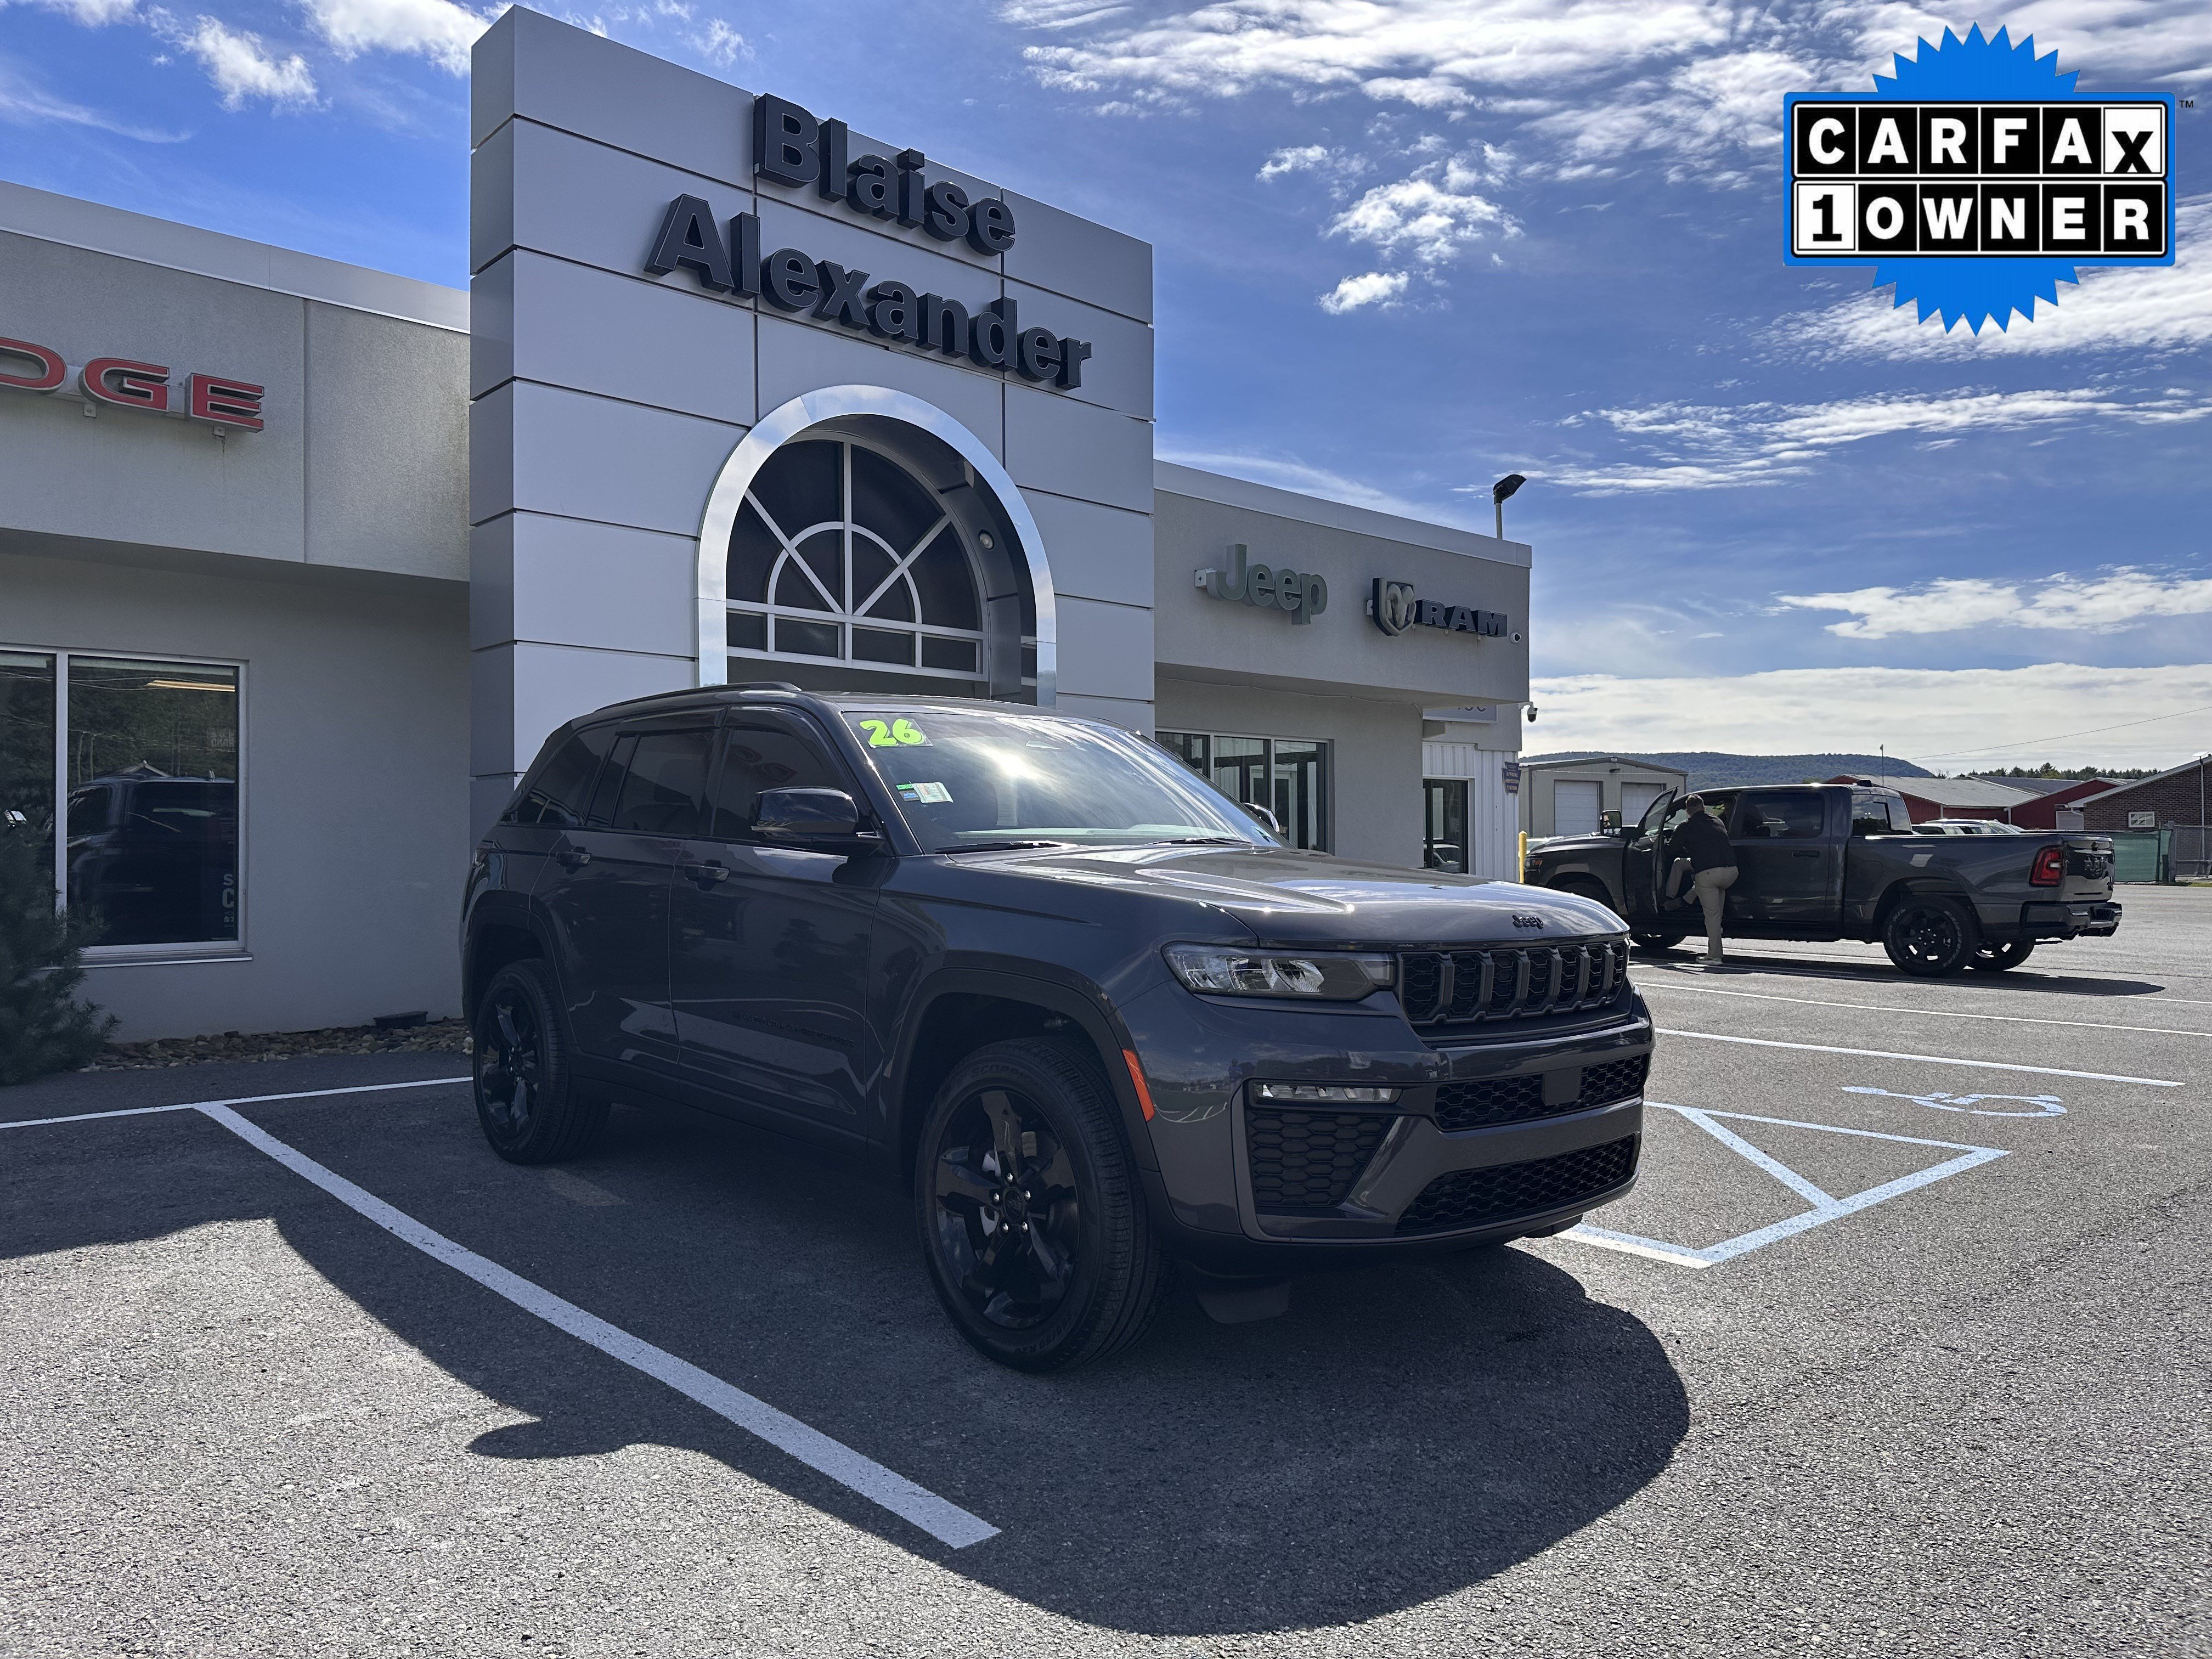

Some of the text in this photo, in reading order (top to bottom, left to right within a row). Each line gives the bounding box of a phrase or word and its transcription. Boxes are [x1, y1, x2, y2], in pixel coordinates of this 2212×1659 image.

[754, 92, 1016, 257] Blaise
[644, 193, 1092, 391] Alexander
[1206, 543, 1328, 625] Jeep
[1414, 599, 1508, 637] RAM
[859, 719, 926, 747] 26
[1512, 915, 1544, 929] Jeep
